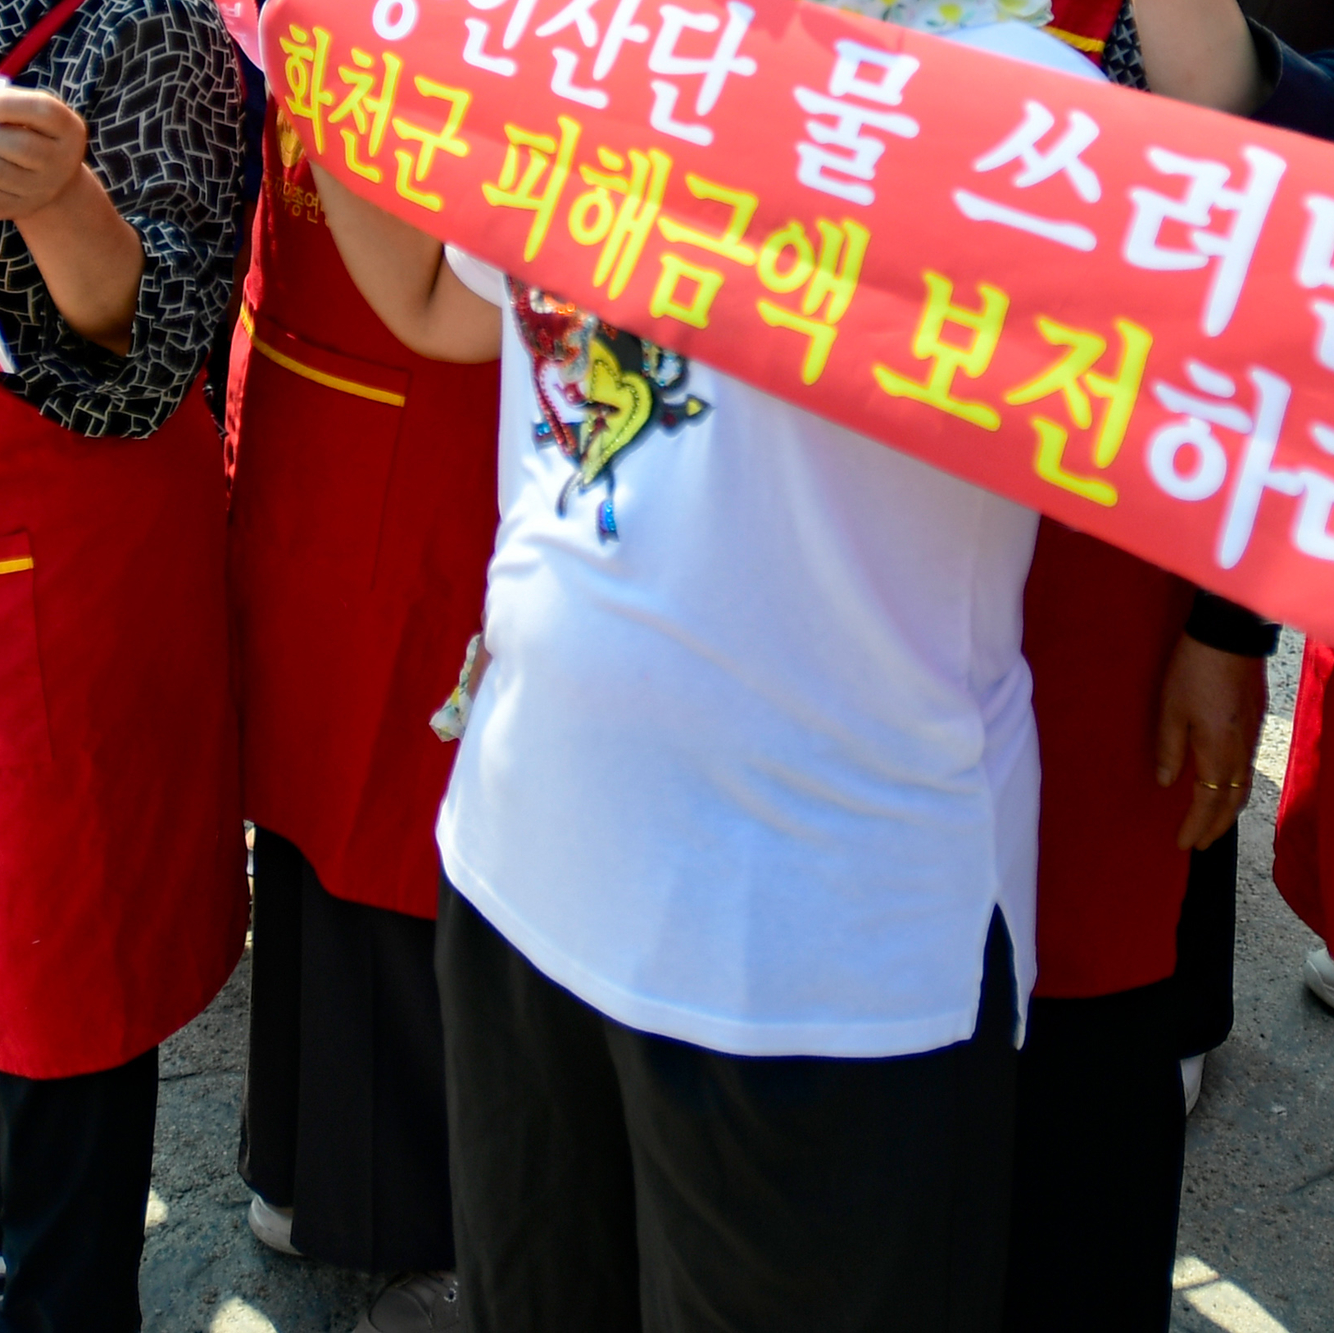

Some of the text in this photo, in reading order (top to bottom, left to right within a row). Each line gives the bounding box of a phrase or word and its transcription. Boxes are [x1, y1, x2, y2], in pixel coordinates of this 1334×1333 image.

[279, 22, 474, 214] 화천군
[481, 114, 872, 387] 피해금액
[792, 38, 922, 207] 물
